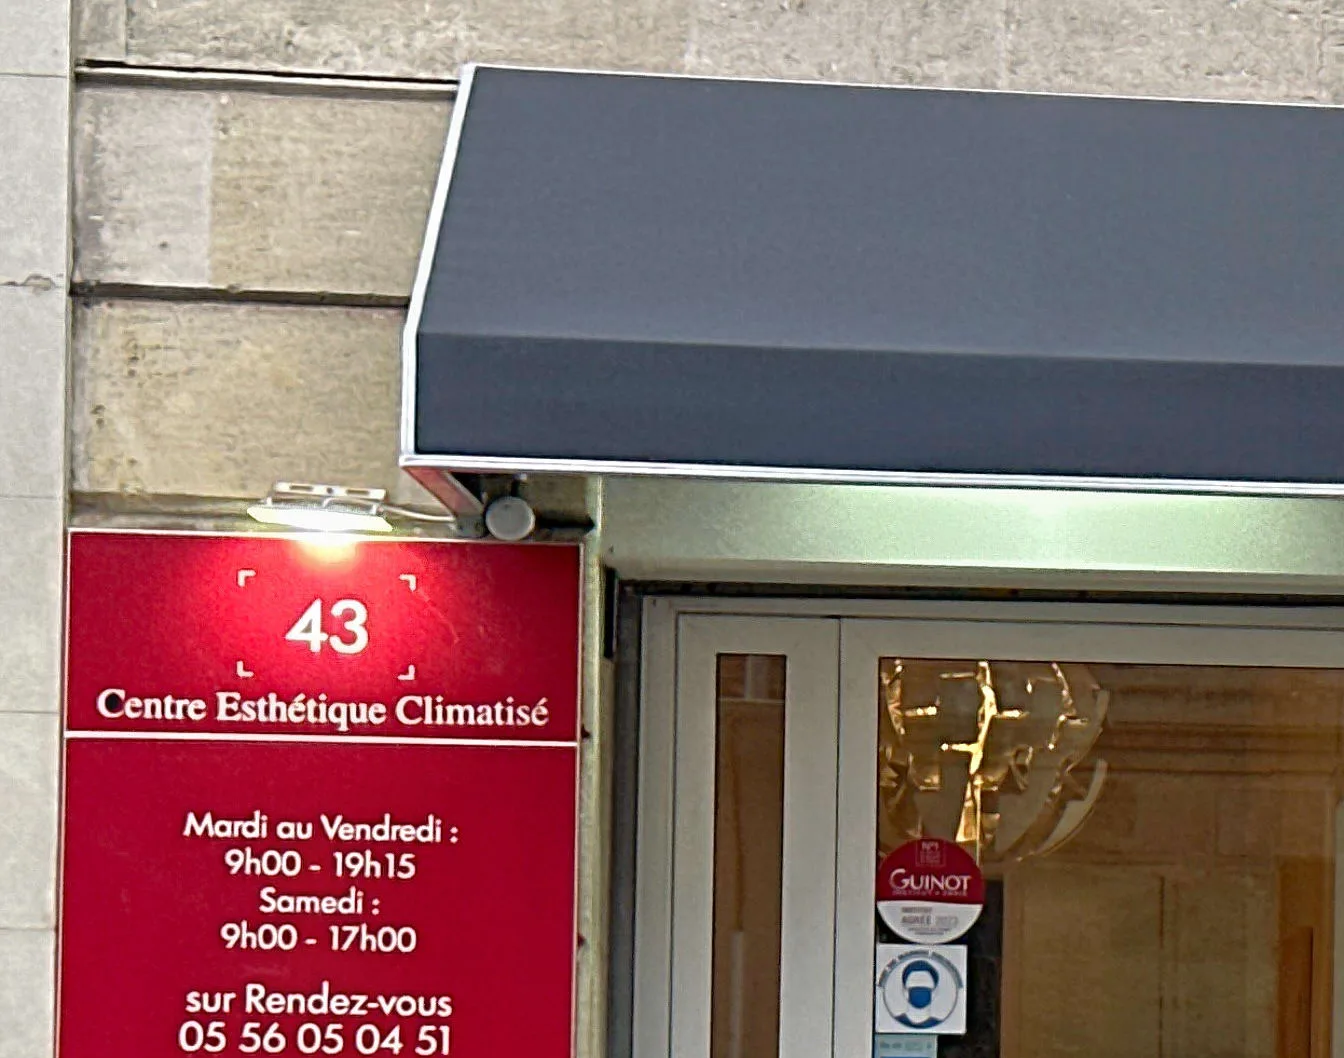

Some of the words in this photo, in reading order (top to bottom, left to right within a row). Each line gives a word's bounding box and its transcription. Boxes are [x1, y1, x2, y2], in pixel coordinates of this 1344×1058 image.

[285, 599, 369, 655] 43
[97, 688, 206, 722] Centre
[216, 692, 387, 731] Esthétique
[395, 695, 549, 727] Climatisé
[183, 811, 268, 839] Mardi
[276, 820, 313, 840] au
[320, 814, 442, 843] Vendredi
[224, 849, 301, 878] 9h00
[334, 851, 416, 879] 19h15
[259, 886, 363, 915] Samedi
[220, 923, 297, 952] 9h00
[330, 925, 417, 953] 17h00
[185, 991, 236, 1014] sur
[245, 981, 453, 1018] Rendez-vous
[178, 1022, 227, 1054] 05
[238, 1023, 286, 1054] 56
[296, 1024, 344, 1055] 05
[355, 1024, 404, 1056] 04
[414, 1025, 451, 1056] 51
